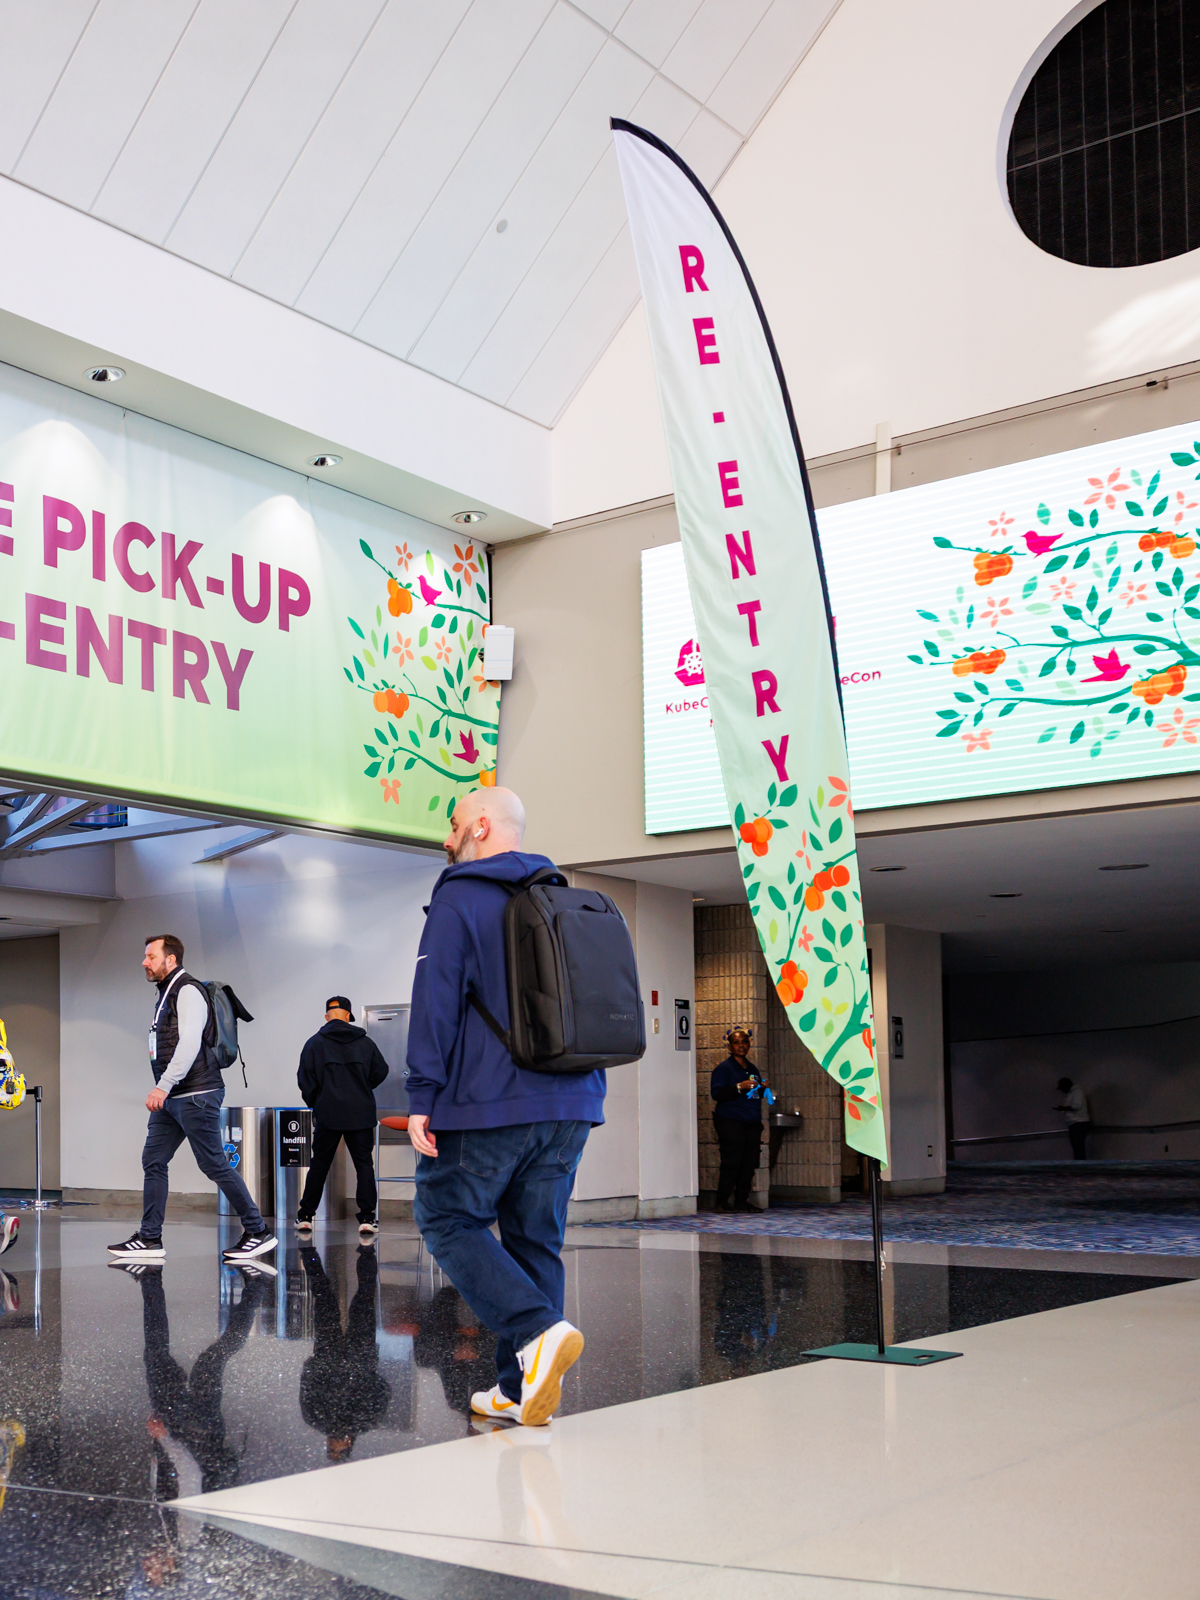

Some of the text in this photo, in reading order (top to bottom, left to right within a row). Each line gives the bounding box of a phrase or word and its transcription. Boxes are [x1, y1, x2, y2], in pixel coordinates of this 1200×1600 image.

[678, 244, 790, 783] RE-ENTRY
[42, 494, 312, 632] PICK-UP
[665, 695, 709, 715] KubeC
[282, 1136, 307, 1144] landfill
